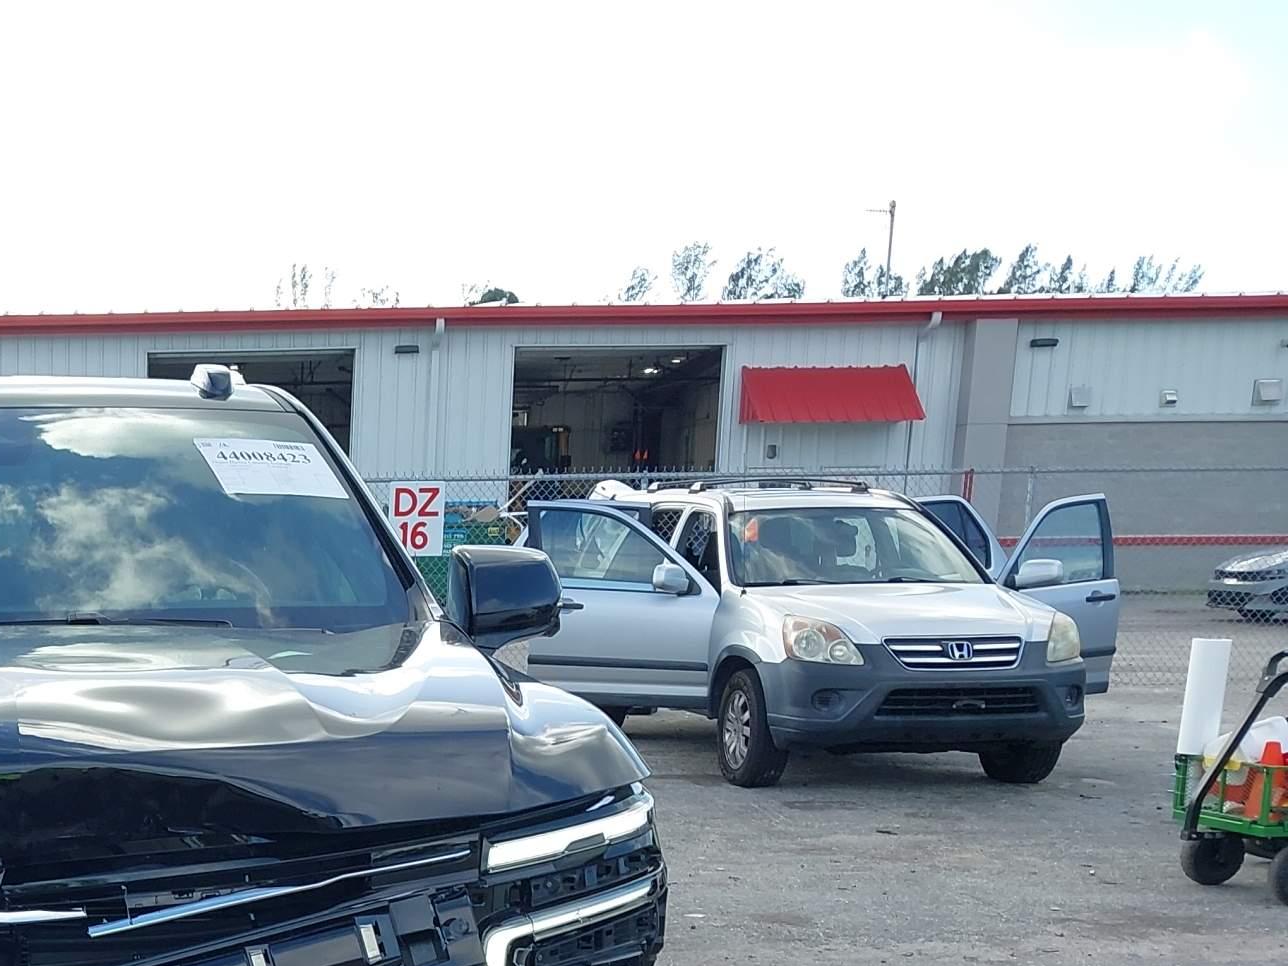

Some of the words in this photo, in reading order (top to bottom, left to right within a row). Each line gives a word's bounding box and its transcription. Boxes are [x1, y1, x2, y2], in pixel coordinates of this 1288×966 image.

[216, 450, 312, 465] 44008423
[394, 487, 440, 517] DZ
[399, 521, 428, 550] 16
